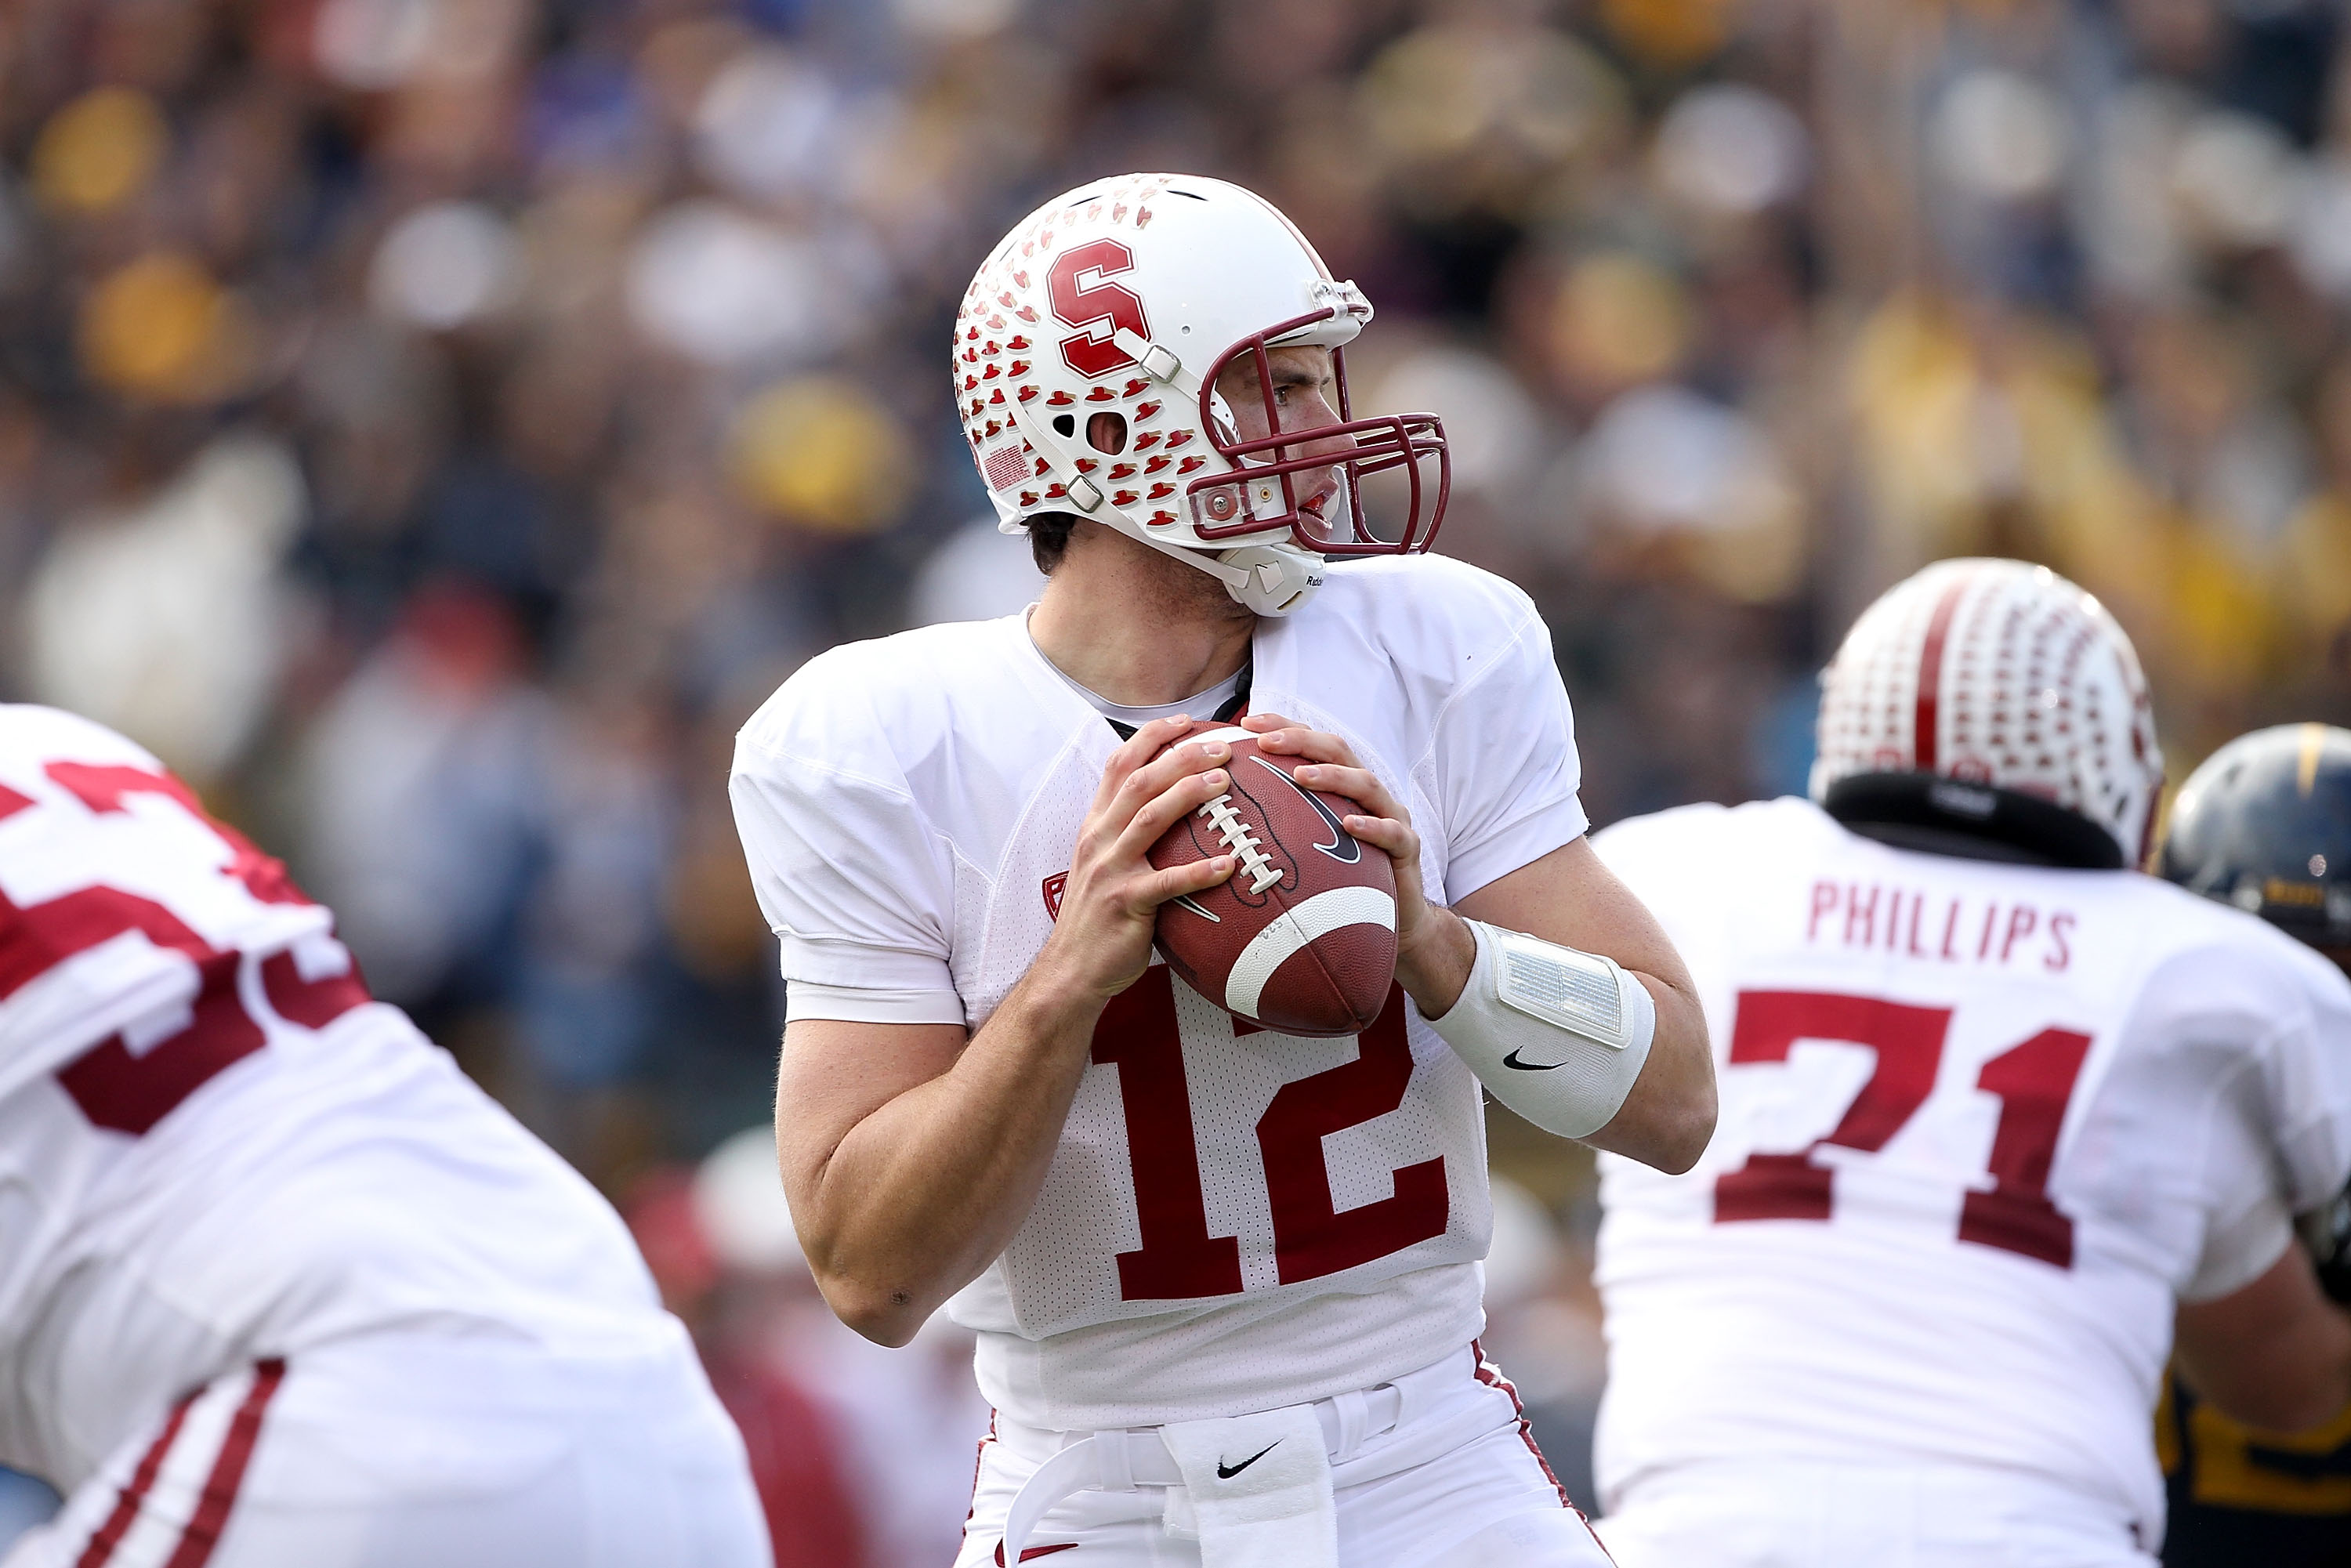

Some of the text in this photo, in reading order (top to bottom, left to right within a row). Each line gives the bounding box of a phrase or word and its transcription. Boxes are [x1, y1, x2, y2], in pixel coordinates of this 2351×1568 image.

[1047, 237, 1152, 380] S
[1806, 879, 2081, 973] PHILLIPS
[1091, 963, 1450, 1302] 12
[1712, 988, 2095, 1269] 71
